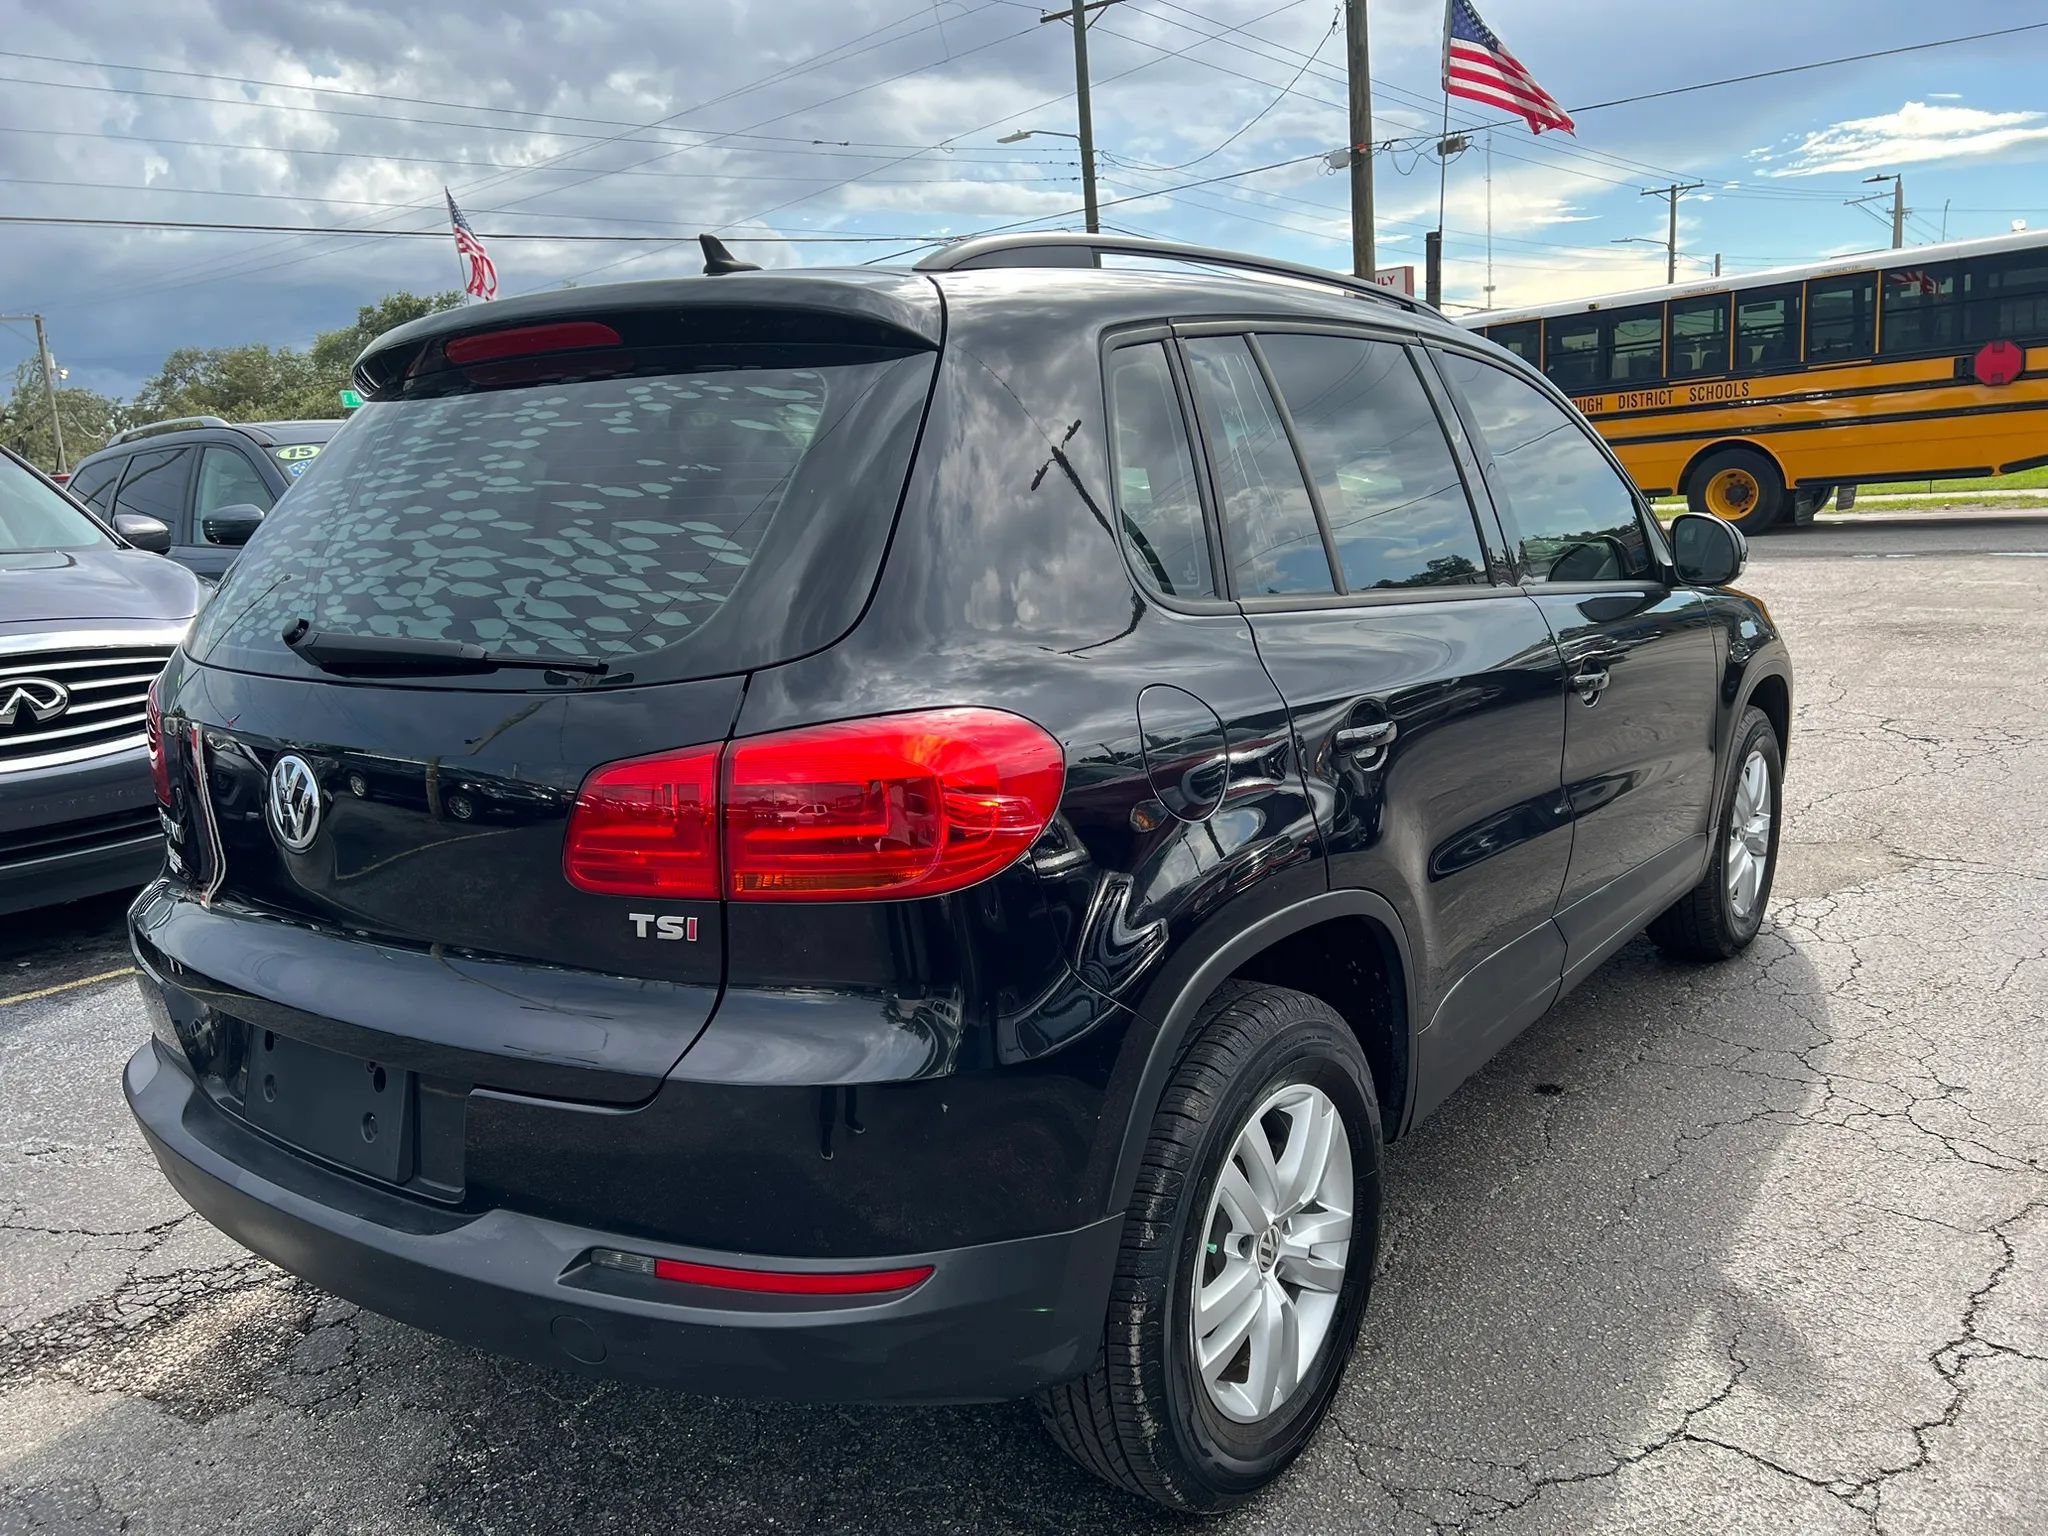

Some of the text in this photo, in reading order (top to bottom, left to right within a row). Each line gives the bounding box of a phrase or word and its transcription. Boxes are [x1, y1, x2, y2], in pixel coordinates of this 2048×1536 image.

[1618, 389, 1674, 409] DISTRICT
[1689, 381, 1750, 402] SCHOOLS
[287, 446, 313, 459] 15
[628, 912, 698, 942] TSI
